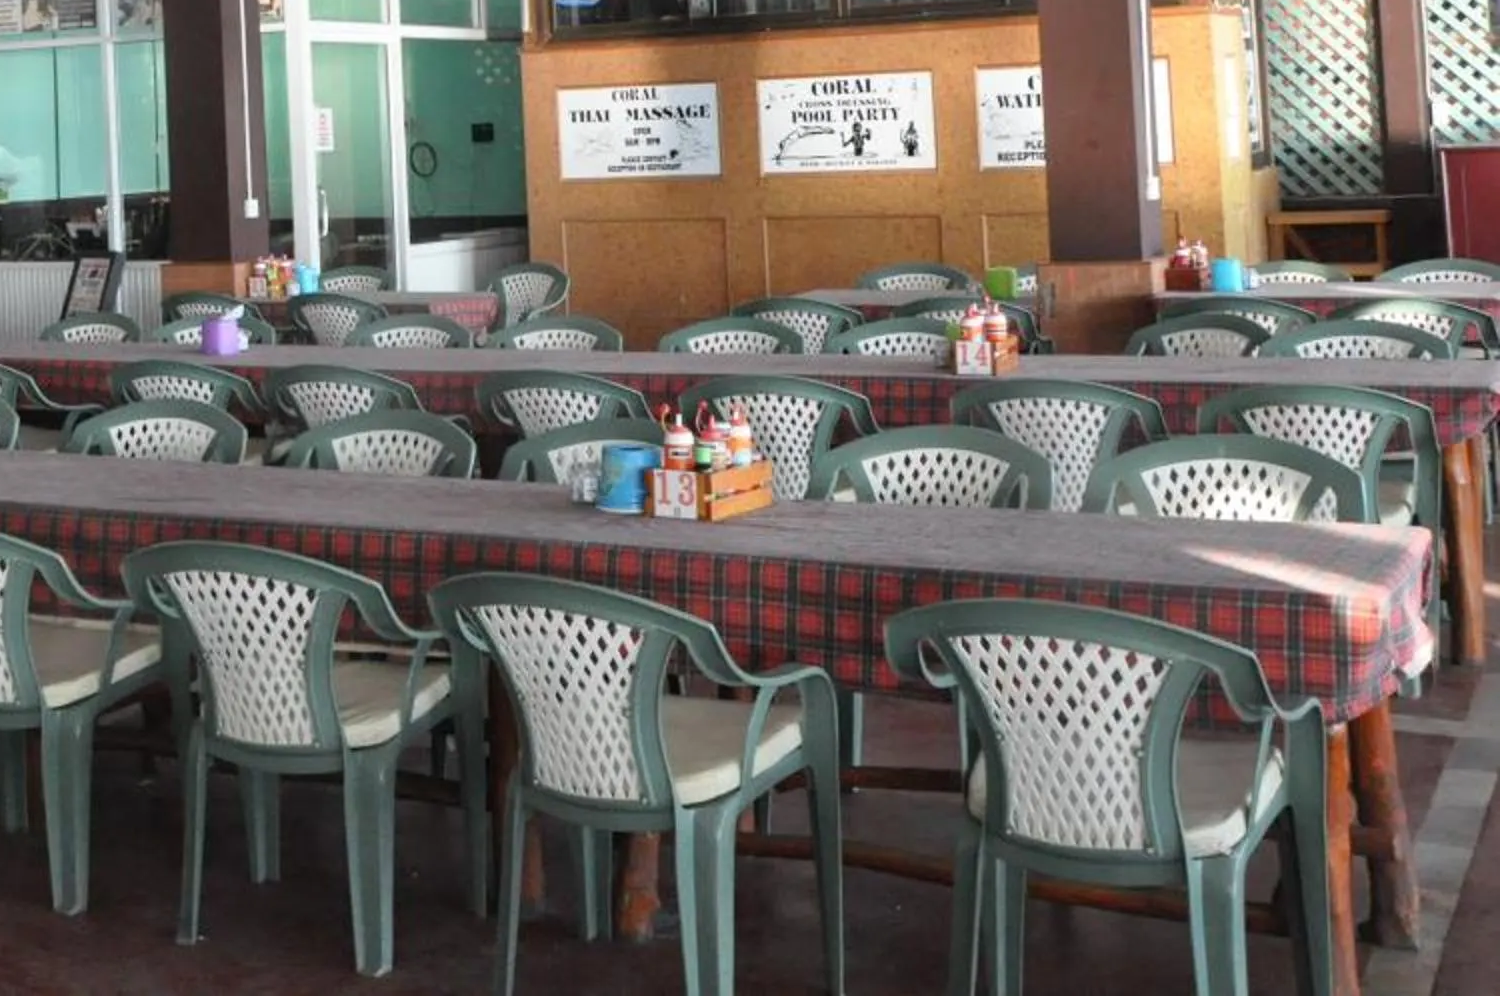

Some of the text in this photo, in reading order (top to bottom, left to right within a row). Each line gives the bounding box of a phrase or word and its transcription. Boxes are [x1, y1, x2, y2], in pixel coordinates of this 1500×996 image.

[611, 87, 660, 102] CORAL
[811, 78, 876, 96] CORAL
[569, 104, 711, 123] THAI MASSAGE
[791, 107, 900, 124] POOL PARTY
[959, 344, 988, 366] 14
[656, 472, 695, 506] 13
